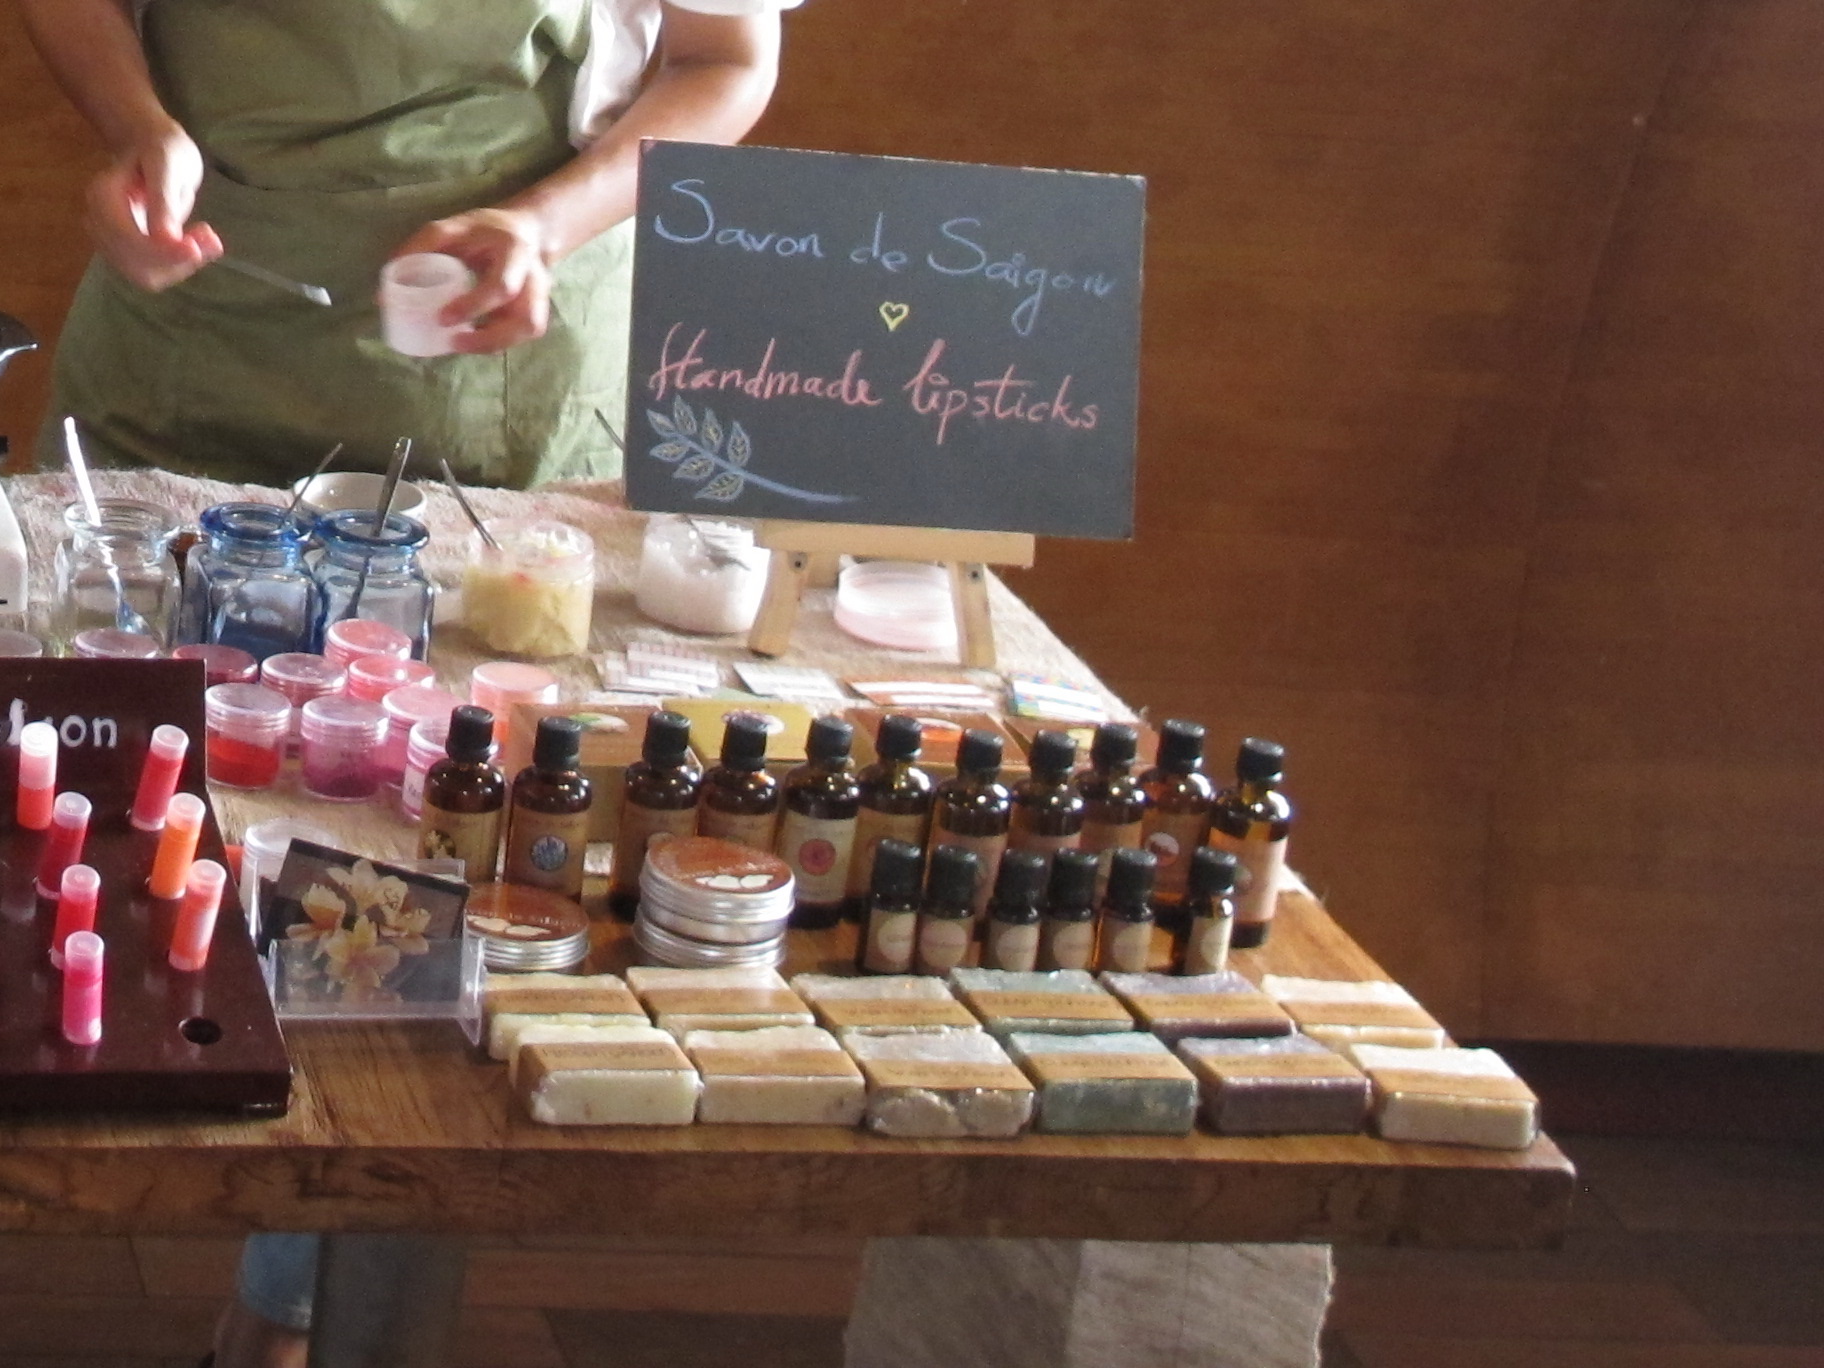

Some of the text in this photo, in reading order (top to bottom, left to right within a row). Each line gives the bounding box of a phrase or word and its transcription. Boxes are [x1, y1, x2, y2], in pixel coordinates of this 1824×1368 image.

[654, 179, 824, 258] Savon
[850, 212, 909, 272] de
[649, 322, 882, 407] Handmade
